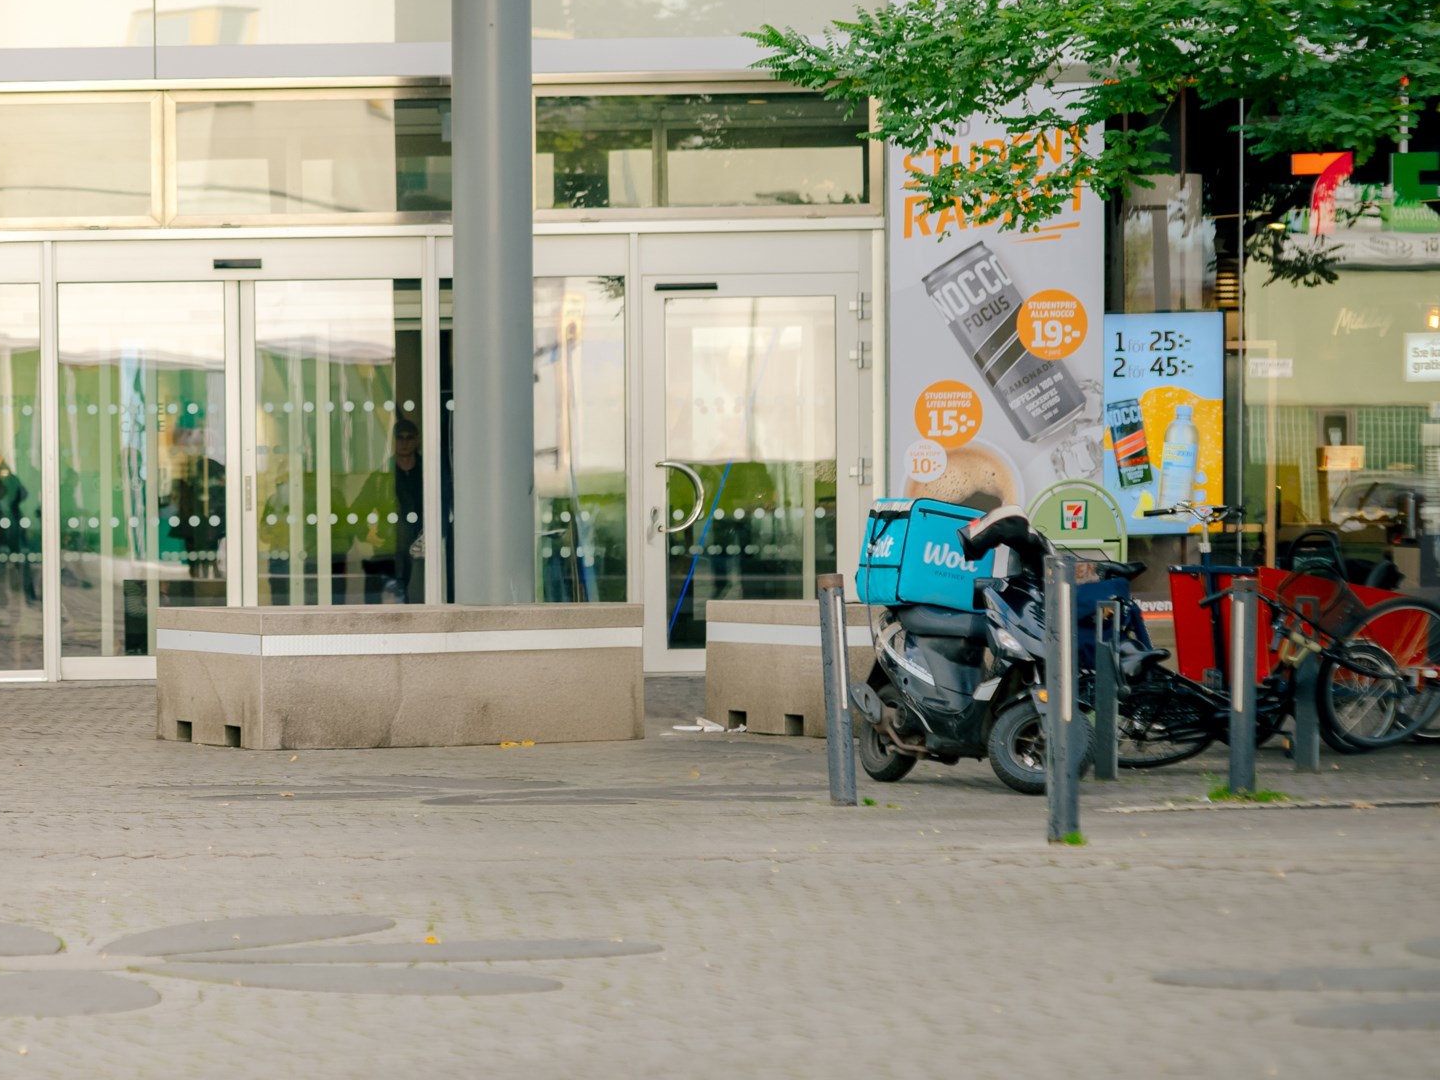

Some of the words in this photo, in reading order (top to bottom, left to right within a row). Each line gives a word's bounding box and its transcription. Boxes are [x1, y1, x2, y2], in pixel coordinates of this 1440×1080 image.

[1028, 301, 1077, 310] STUDENTPRIS
[1031, 310, 1049, 318] ALLA
[1050, 310, 1075, 318] NOCCO
[963, 295, 1010, 335] FOCUS
[1031, 320, 1081, 348] 19:-
[1115, 331, 1125, 352] 1
[1113, 357, 1126, 378] 2
[925, 391, 973, 400] STUDENTPRIS
[927, 409, 976, 437] 15:-
[911, 457, 943, 474] 10:-
[934, 570, 965, 581] PARTNER
[1134, 599, 1174, 612] leven
